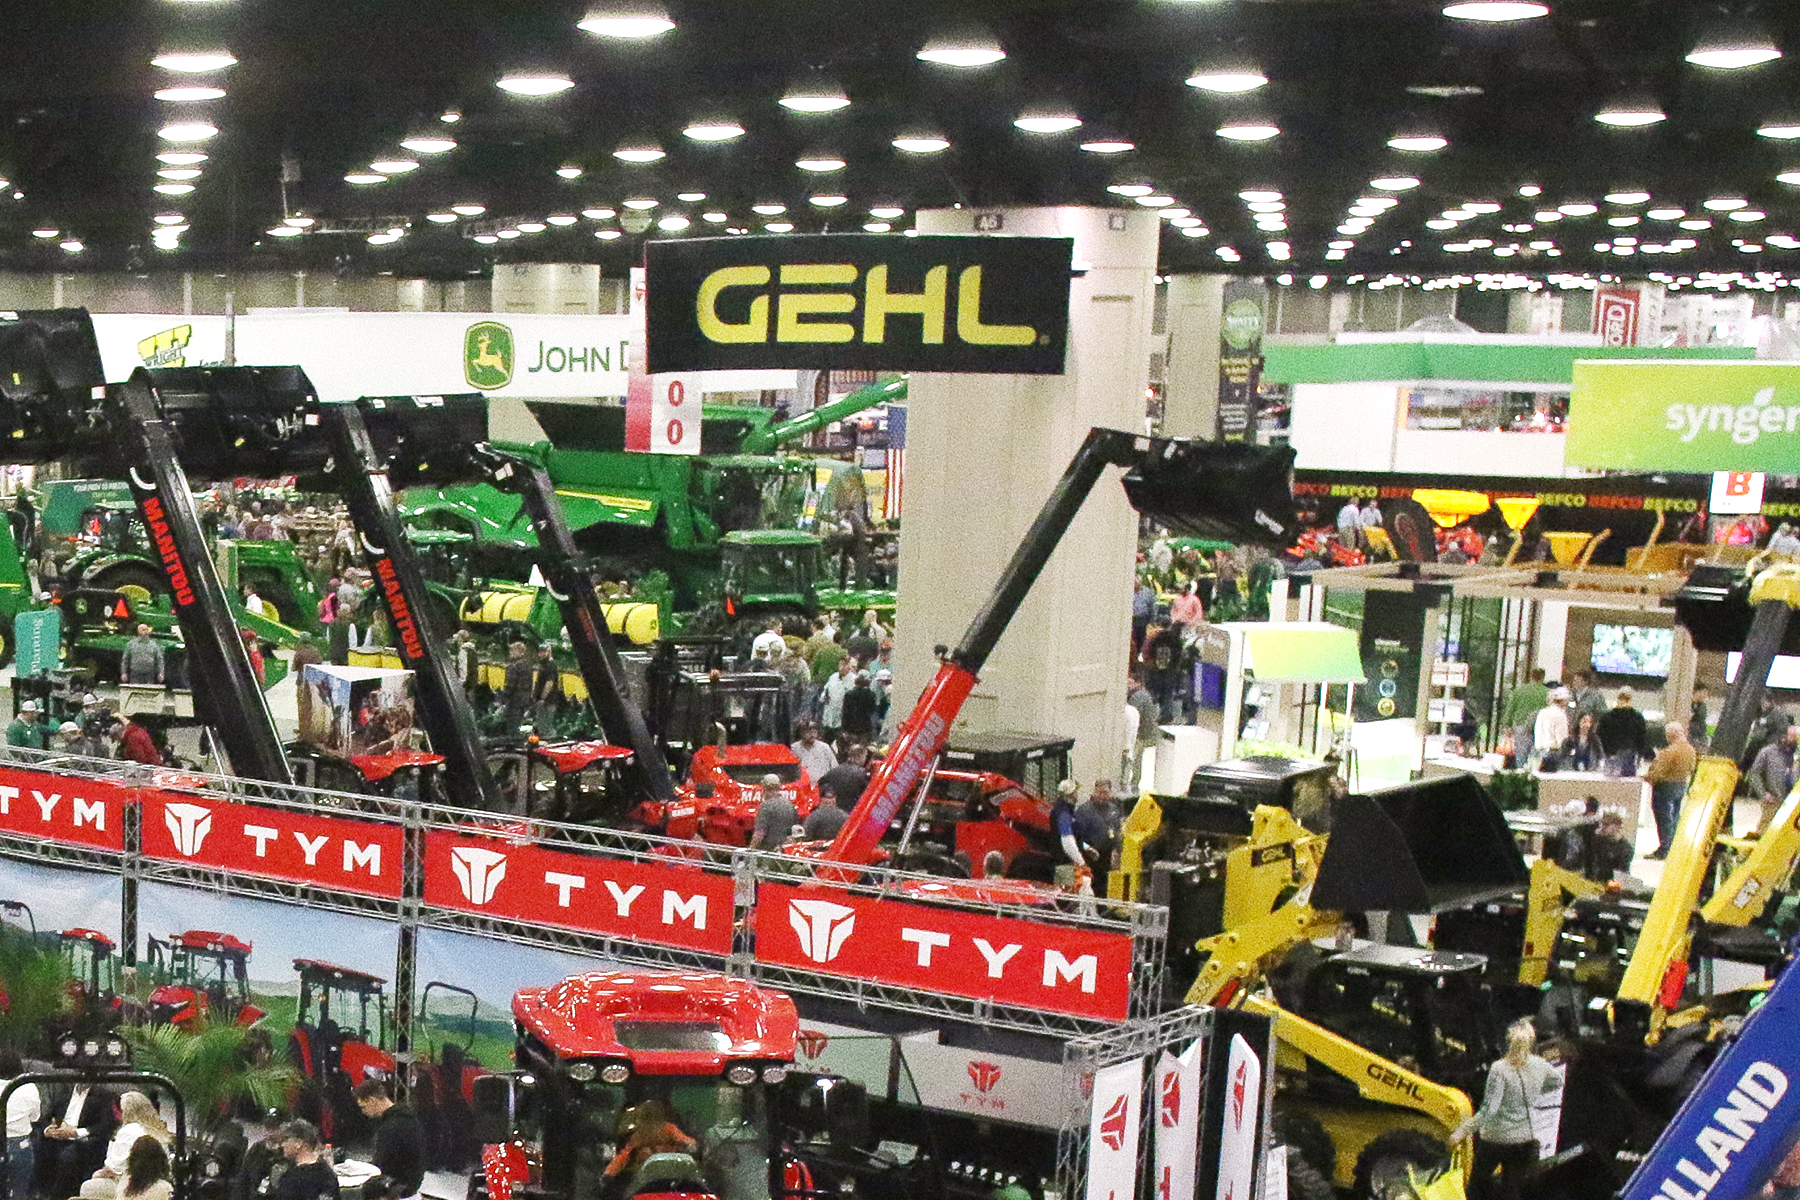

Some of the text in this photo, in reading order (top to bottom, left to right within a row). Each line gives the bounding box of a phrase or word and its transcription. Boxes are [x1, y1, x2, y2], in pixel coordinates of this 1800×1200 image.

[696, 264, 1037, 345] GEHL
[527, 340, 611, 374] JOHN
[143, 497, 196, 607] MANITOU
[376, 557, 425, 659] MANITOU
[243, 824, 382, 877] TYM
[543, 871, 708, 931] TYM
[901, 927, 1099, 995] TYM
[1366, 1062, 1435, 1103] GEHL
